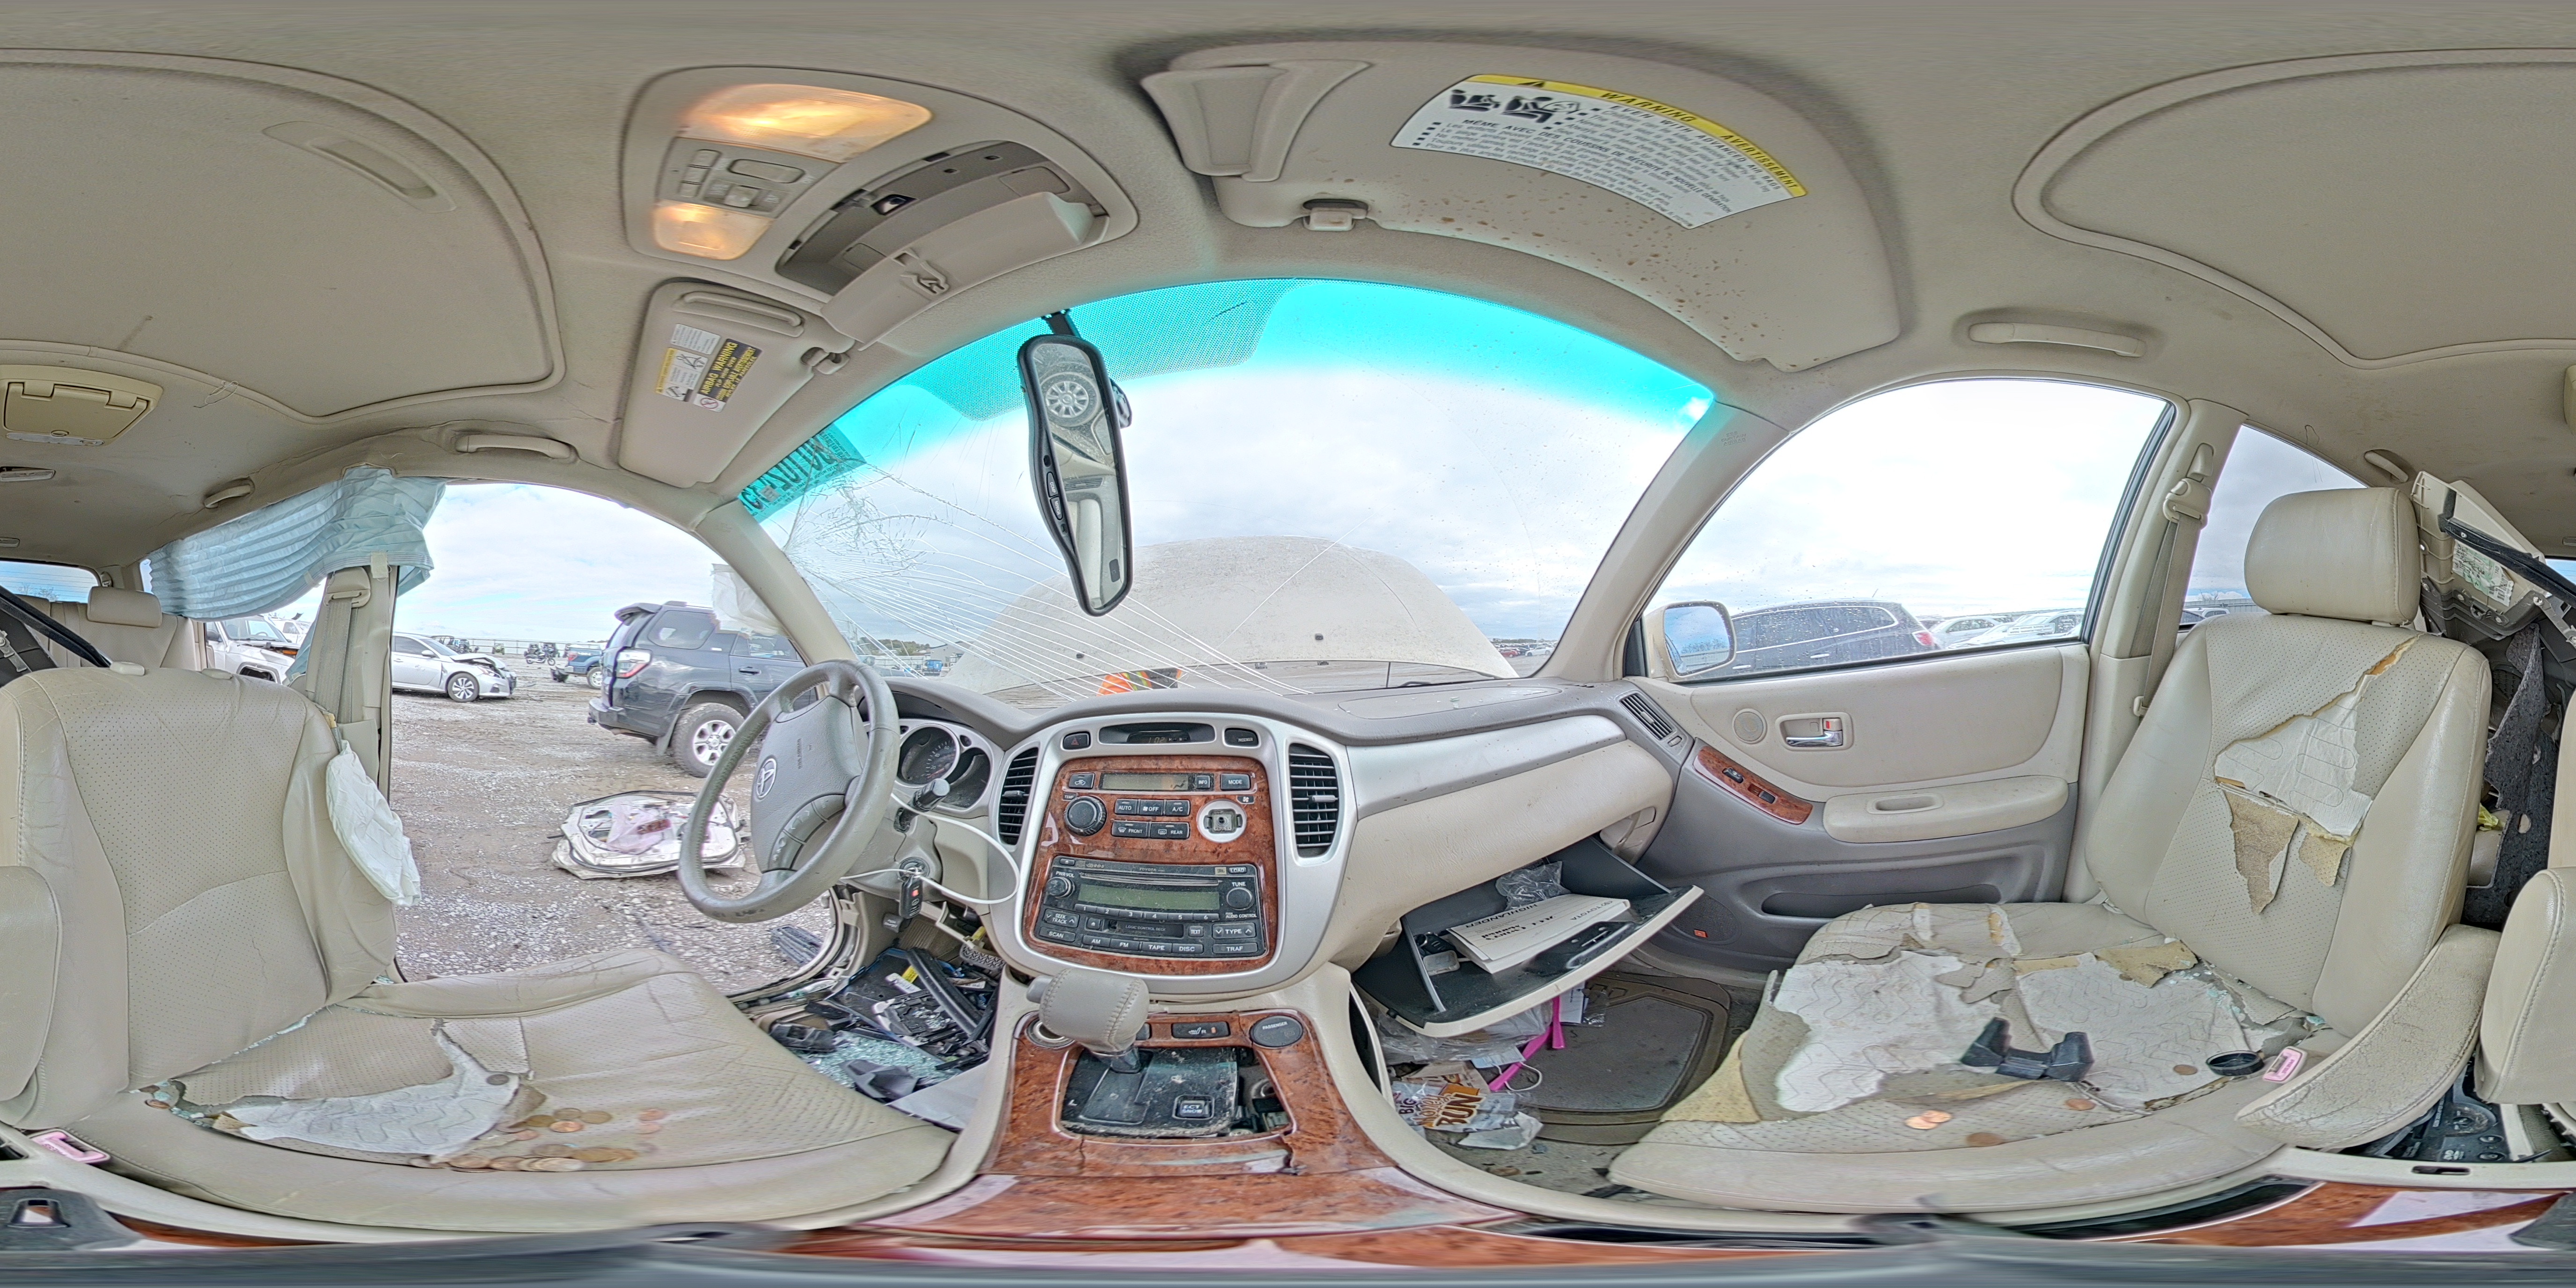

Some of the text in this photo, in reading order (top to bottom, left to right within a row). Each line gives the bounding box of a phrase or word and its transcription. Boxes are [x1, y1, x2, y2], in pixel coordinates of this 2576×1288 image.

[1595, 93, 1699, 122] WARNING
[1608, 105, 1782, 190] EVEN WITH ADVANCED AIR BAGS
[1719, 134, 1799, 189] AVERTISSEMENT
[1462, 118, 1502, 127] MÊME
[1502, 125, 1537, 133] AVEC
[1562, 137, 1611, 152] COUSSINS
[1624, 155, 1664, 171] SÉCURITÉ
[1671, 176, 1703, 193] NOUVELLE
[1700, 192, 1734, 213] GÉNÉRATION
[700, 340, 738, 395] AIRBAG WARNING
[1465, 903, 1538, 929] HIGHLANDER
[1571, 905, 1603, 921] TOYOTA
[1262, 1021, 1288, 1030] PASSENGER
[1398, 1098, 1417, 1115] BIG
[1435, 1094, 1483, 1127] BUN
